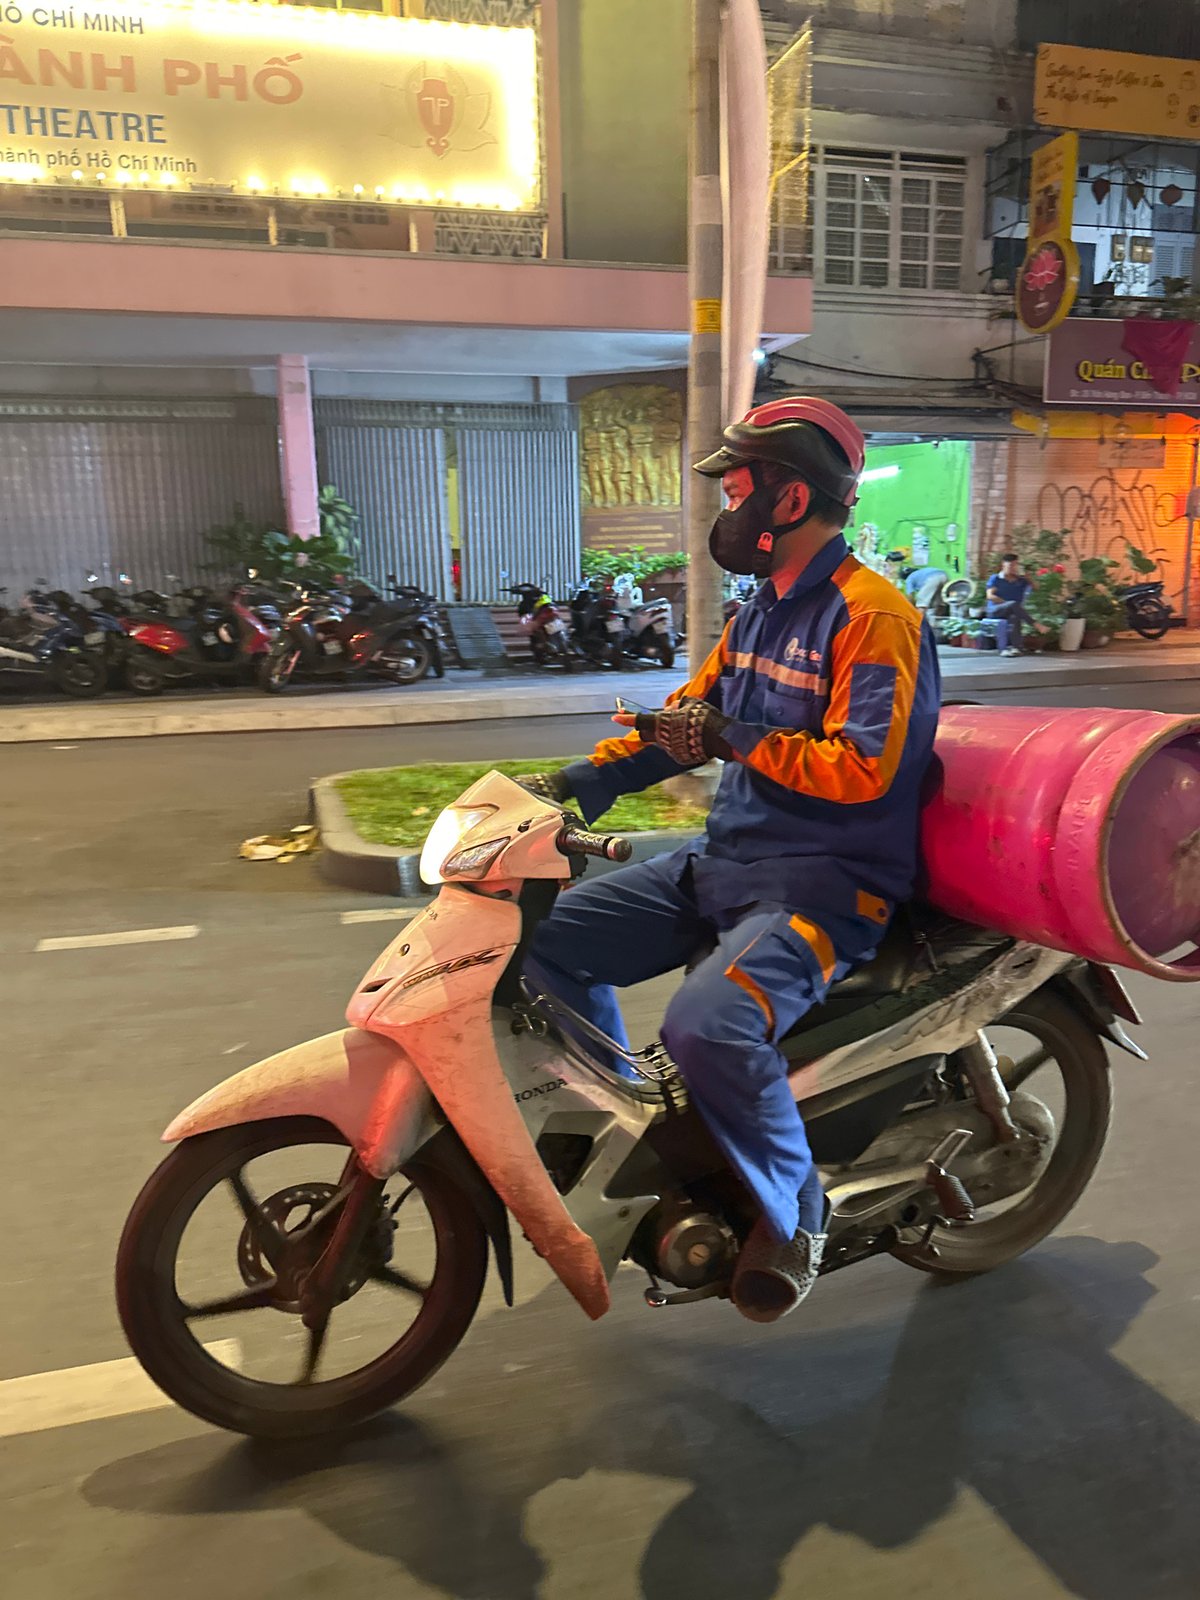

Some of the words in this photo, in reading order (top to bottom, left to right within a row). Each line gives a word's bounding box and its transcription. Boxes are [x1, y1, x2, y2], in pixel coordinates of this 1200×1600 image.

[32, 6, 74, 28] CHÍ
[83, 12, 144, 34] MINH
[162, 53, 303, 104] PHỐ
[0, 104, 167, 144] THEATRE
[47, 148, 82, 168] phố
[87, 150, 112, 169] Hồ
[118, 154, 149, 170] Chí
[153, 156, 198, 173] Minh
[1078, 359, 1127, 382] Quán
